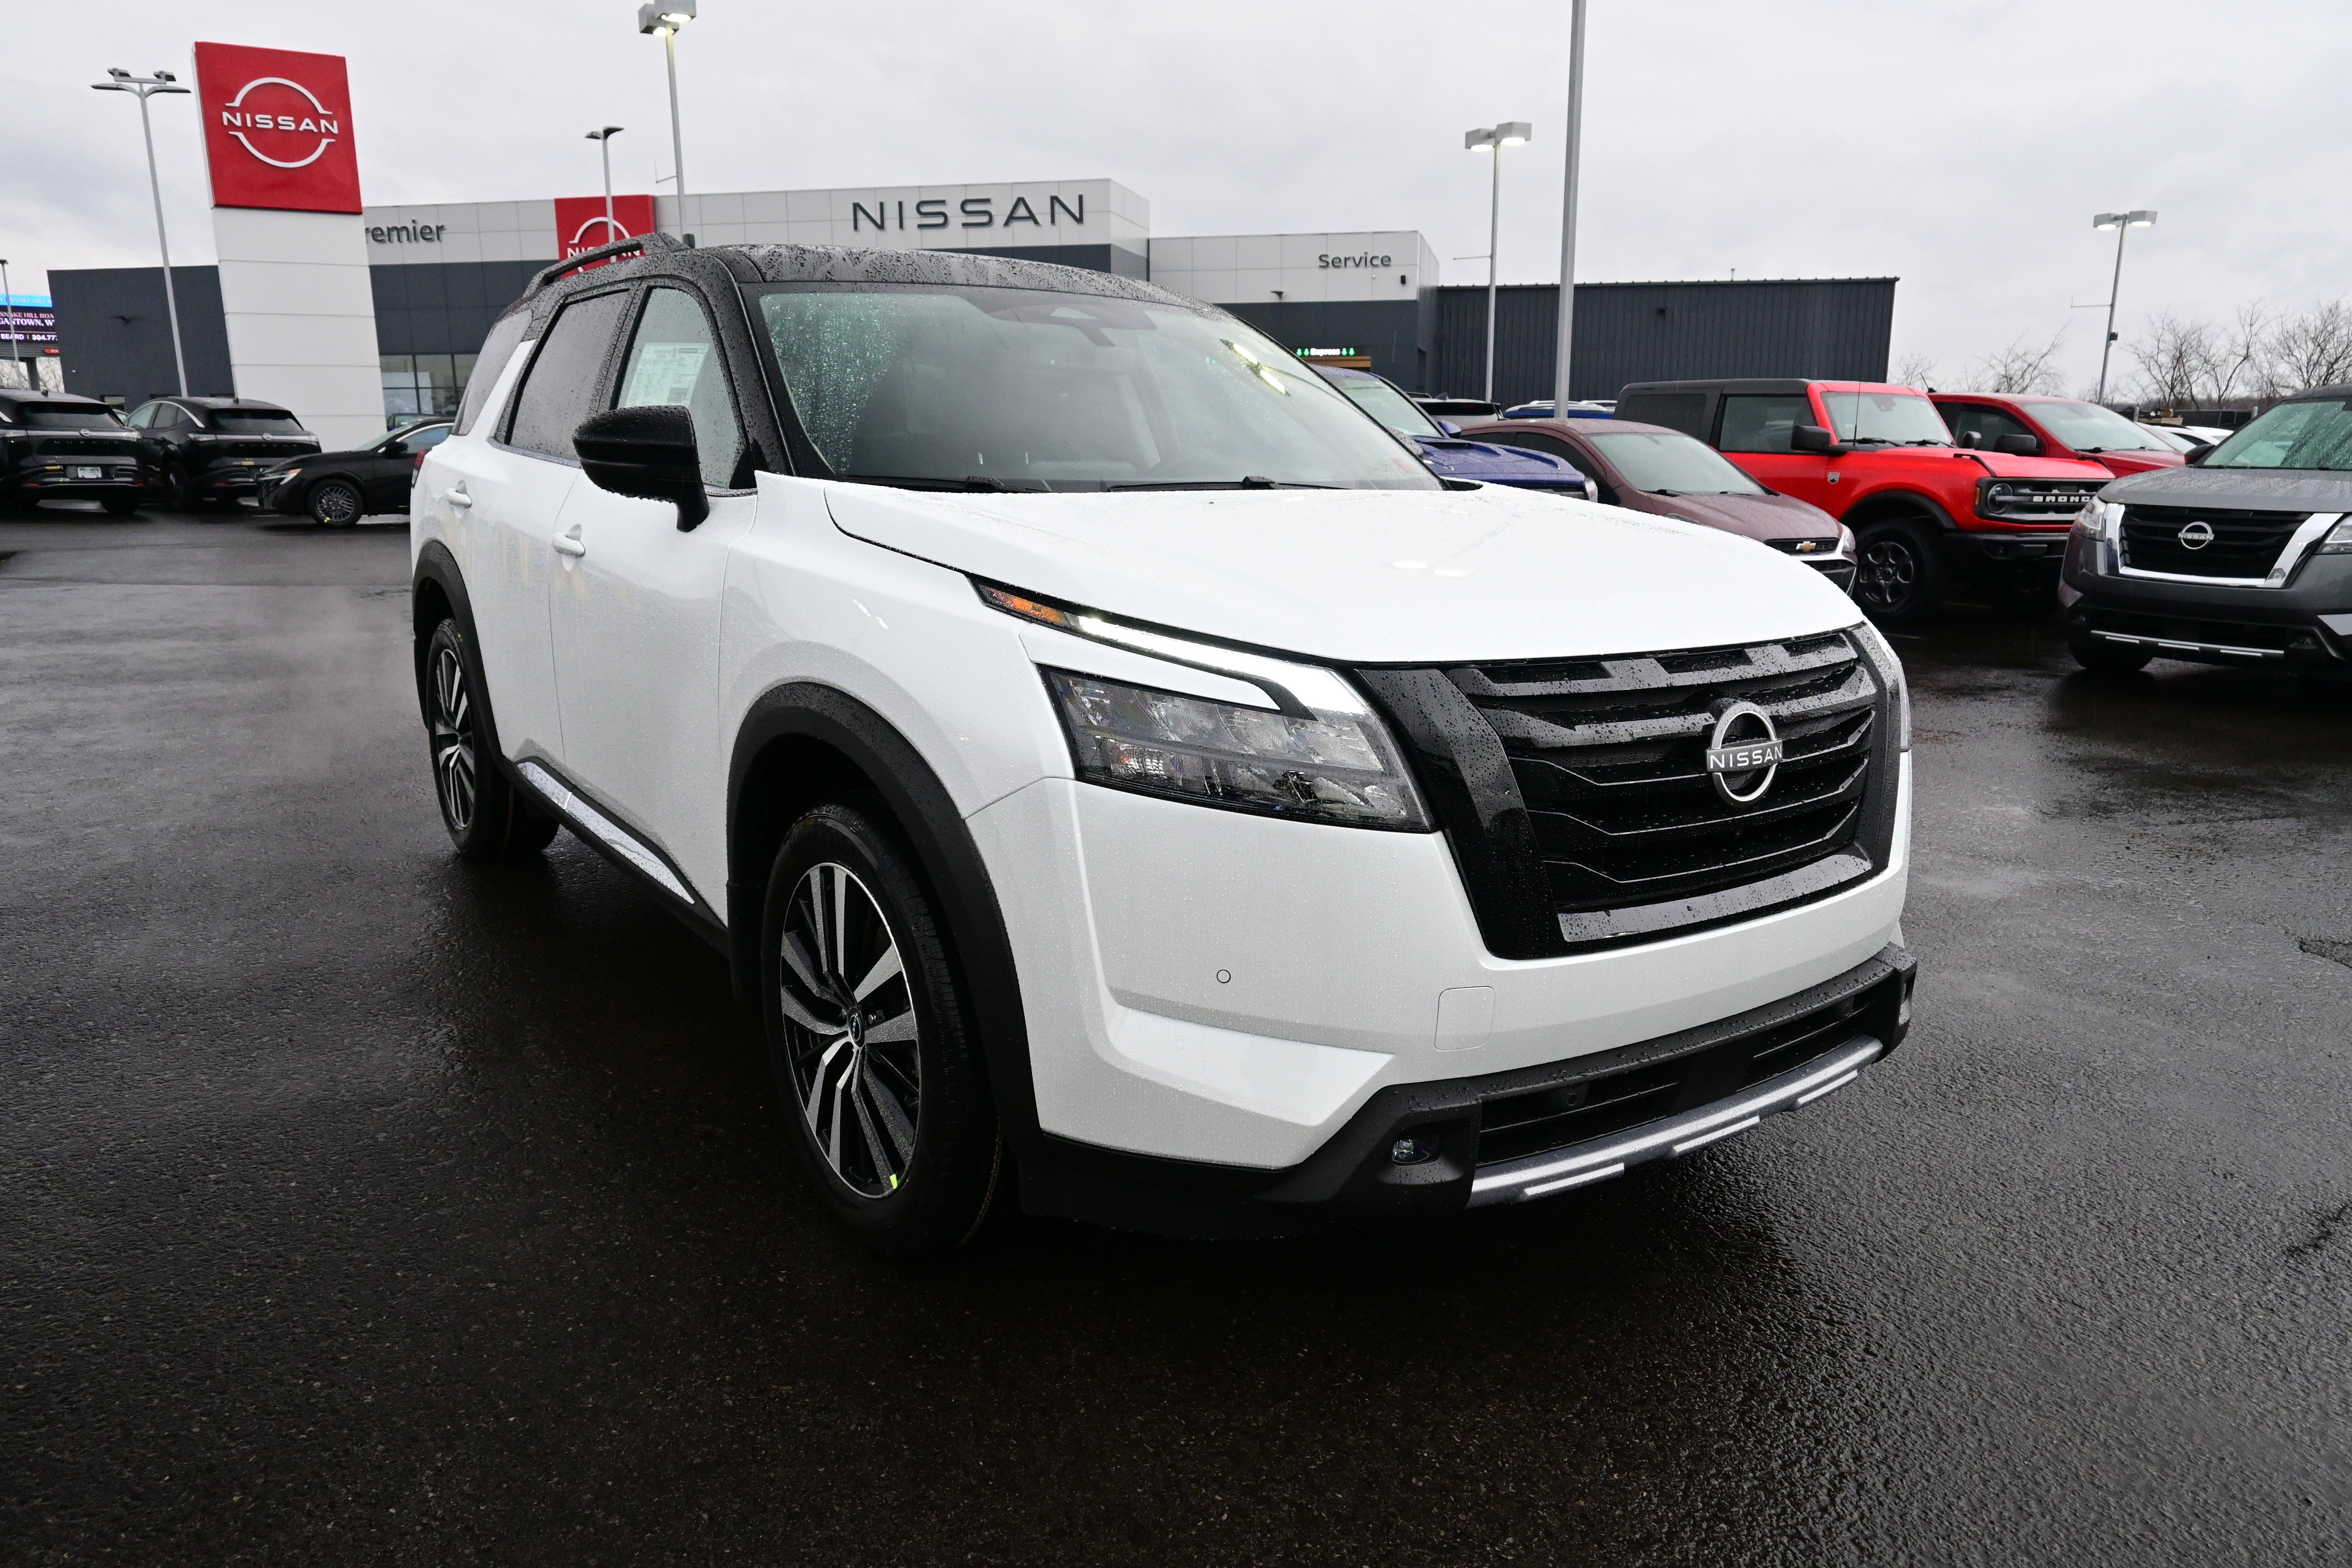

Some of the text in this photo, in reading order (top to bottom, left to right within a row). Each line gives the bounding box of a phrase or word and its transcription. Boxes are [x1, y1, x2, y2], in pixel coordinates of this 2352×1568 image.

[222, 111, 338, 134] NISSAN
[852, 194, 1084, 231] NISSAN
[1319, 251, 1391, 269] Service
[1710, 744, 1782, 769] NISSAN
